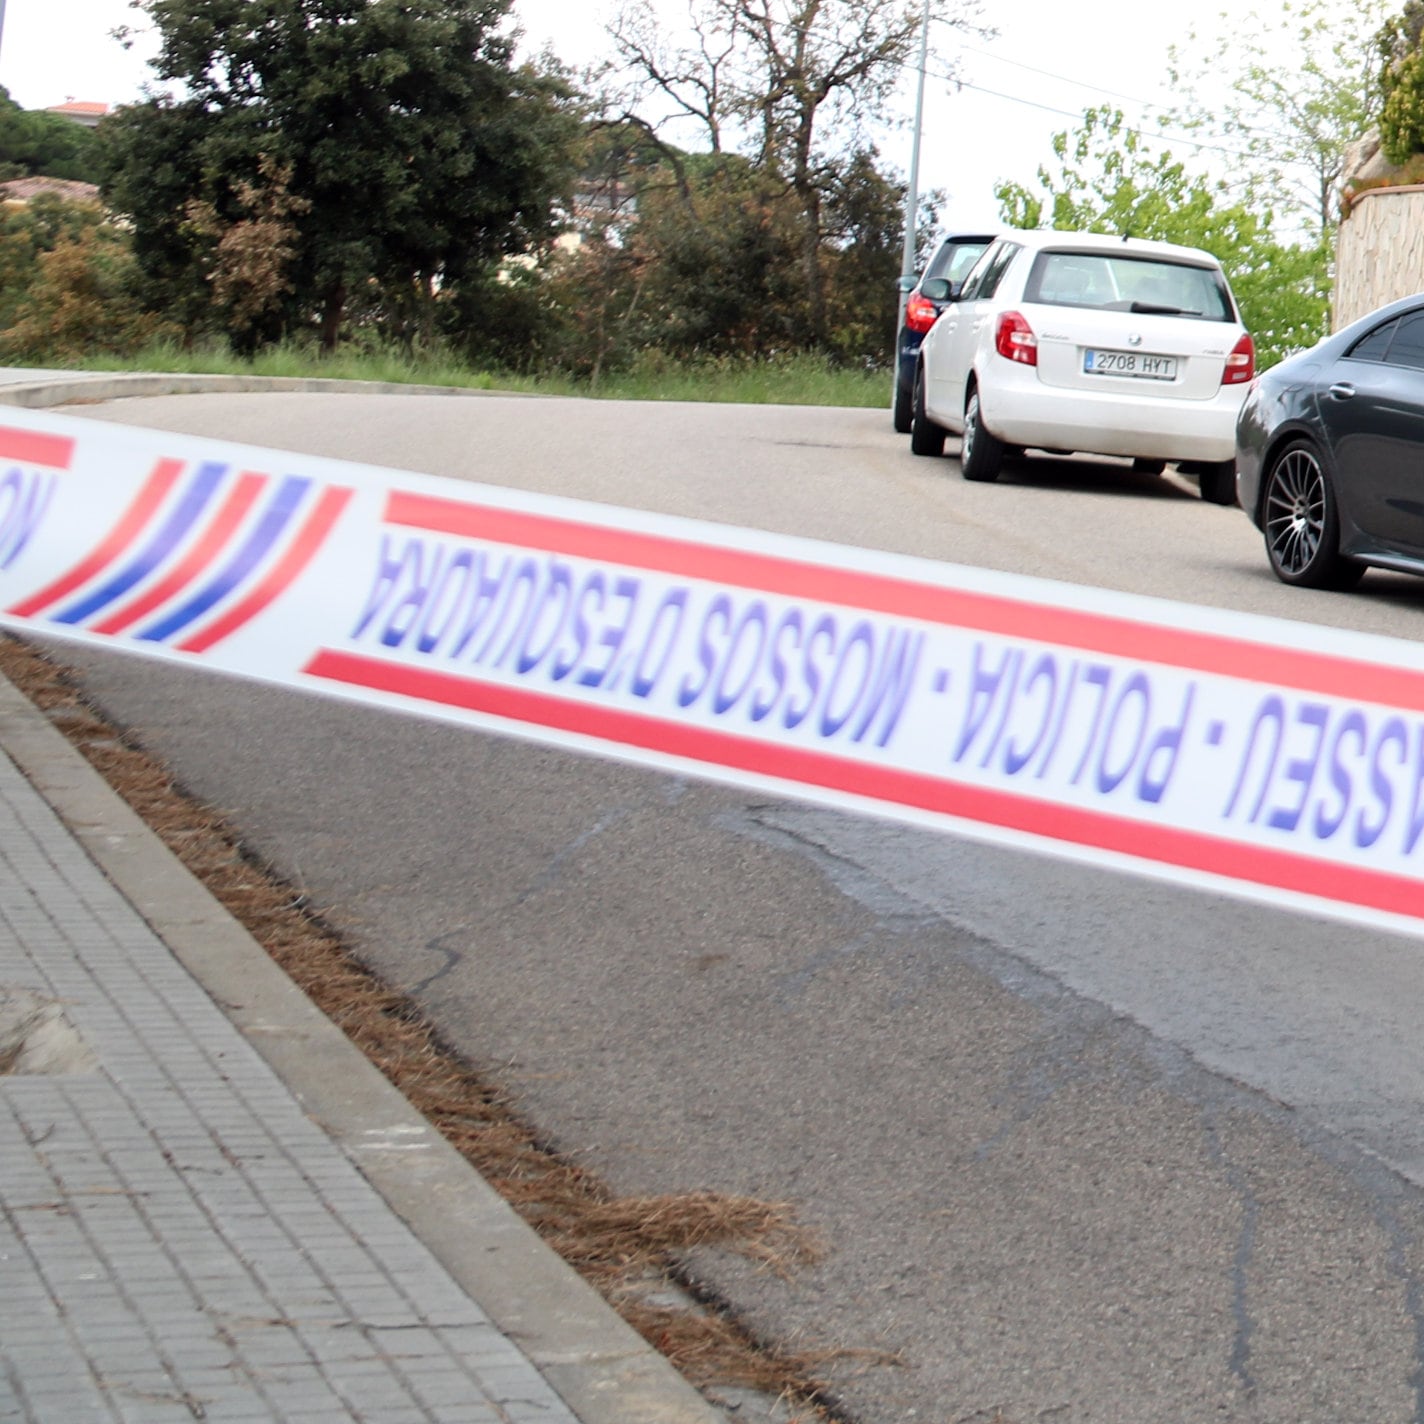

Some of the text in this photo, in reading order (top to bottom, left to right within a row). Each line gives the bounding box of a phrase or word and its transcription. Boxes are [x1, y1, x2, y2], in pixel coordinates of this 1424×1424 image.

[1096, 353, 1172, 374] 2708 HYT
[350, 532, 692, 702] D'ESQUADRA
[675, 591, 926, 751] MOSSOS
[951, 638, 1198, 807] POLICIA
